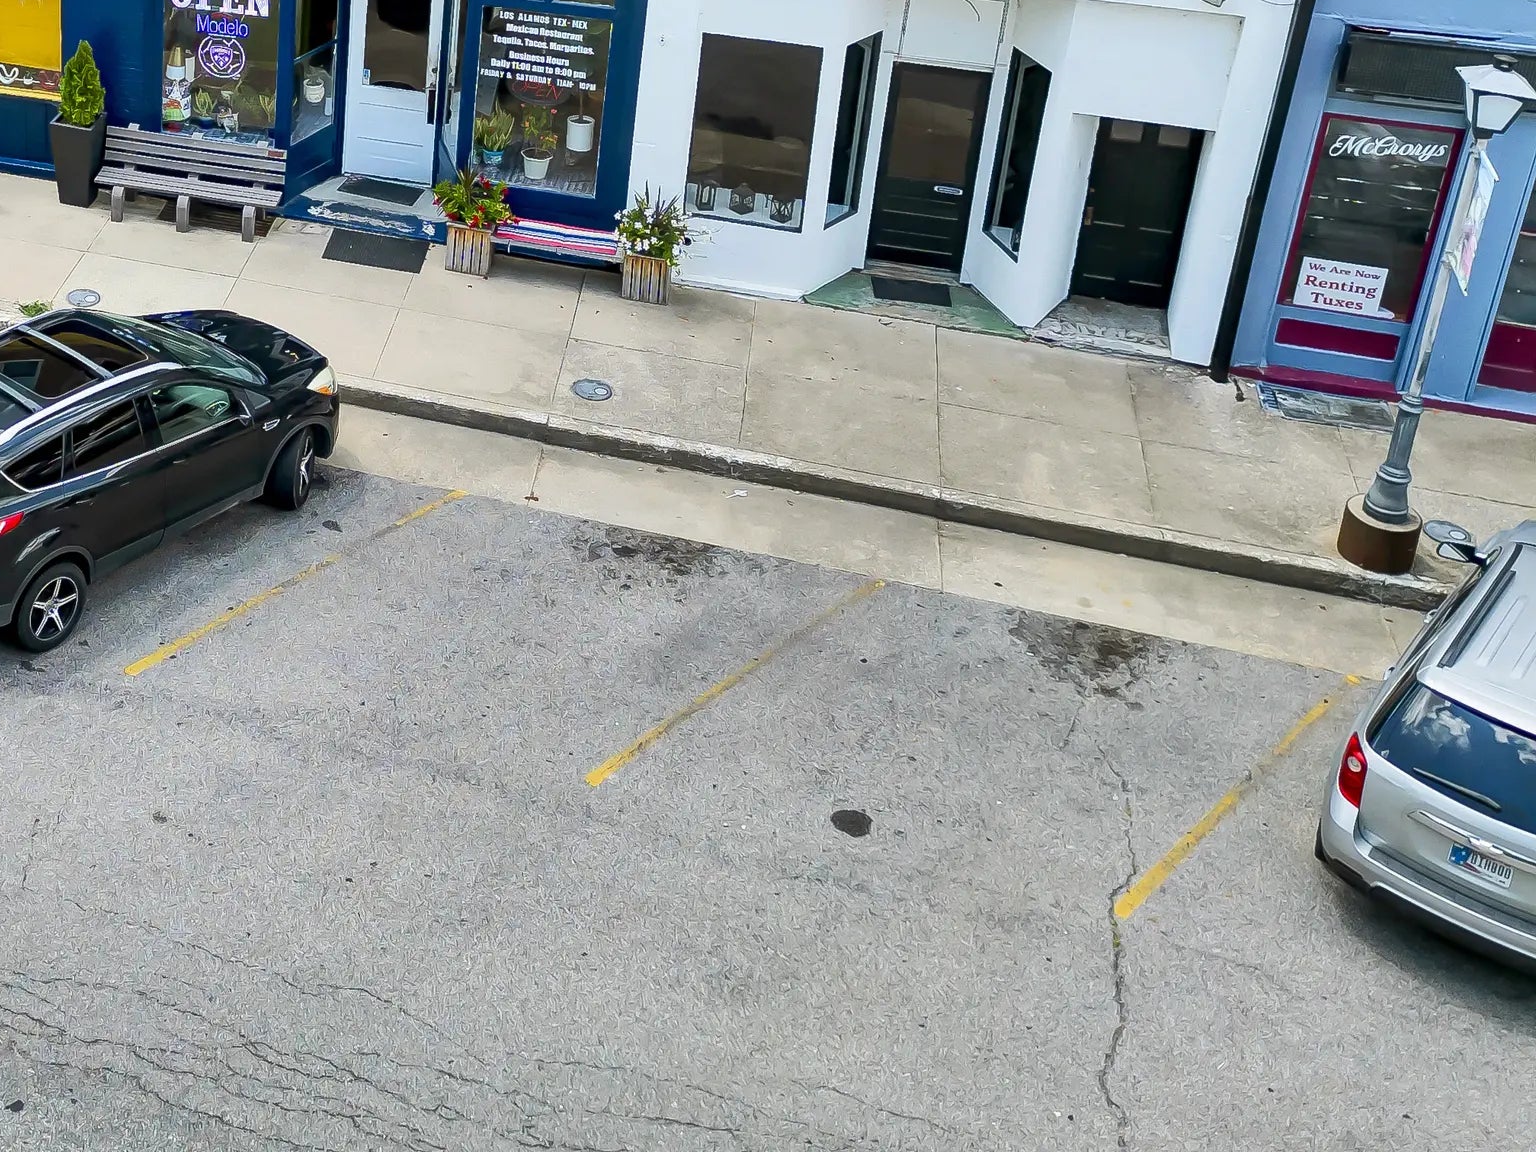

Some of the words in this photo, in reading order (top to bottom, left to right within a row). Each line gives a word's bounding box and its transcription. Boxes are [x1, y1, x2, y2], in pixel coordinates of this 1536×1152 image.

[196, 13, 249, 37] Modelo
[499, 10, 515, 20] LOS
[517, 12, 550, 25] ALAMOS
[506, 23, 539, 35] Mexican
[539, 28, 584, 42] Restaurant
[508, 50, 545, 63] Business
[545, 55, 570, 67] Hours
[490, 58, 510, 69] Daily
[531, 64, 545, 73] am
[545, 66, 554, 74] to
[573, 71, 587, 80] pm
[480, 68, 505, 78] FRIDAY
[506, 71, 513, 79] &
[516, 73, 552, 86] SATURDAY
[579, 81, 597, 91] 10PM
[1328, 134, 1449, 162] McCrorys
[1309, 262, 1326, 273] We
[1329, 266, 1352, 276] Are
[1355, 269, 1382, 280] Now
[1303, 274, 1379, 299] Renting
[1310, 292, 1364, 310] Tuxes
